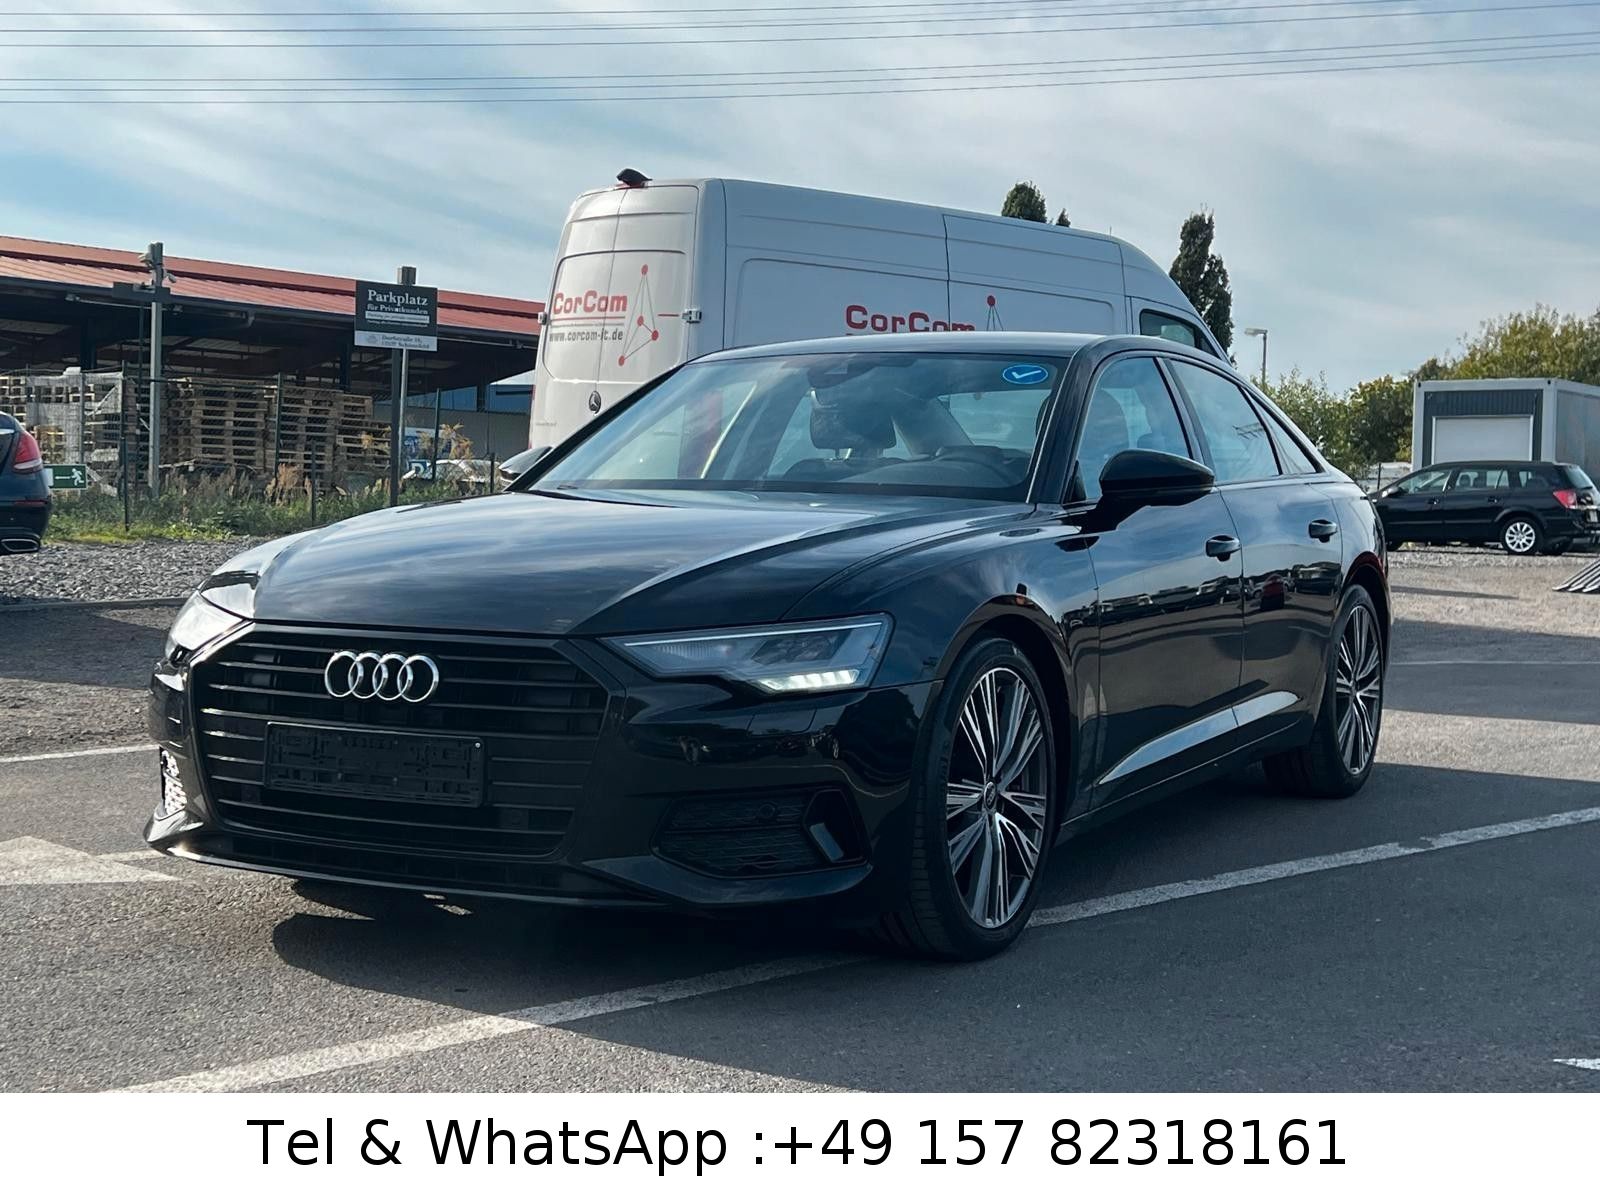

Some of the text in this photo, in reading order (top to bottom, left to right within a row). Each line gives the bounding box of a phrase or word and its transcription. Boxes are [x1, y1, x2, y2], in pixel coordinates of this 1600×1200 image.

[367, 289, 428, 307] Parkplatz
[553, 290, 628, 315] CorCom
[380, 304, 428, 315] Privatkunden
[549, 328, 624, 342] www.corcom-it.de
